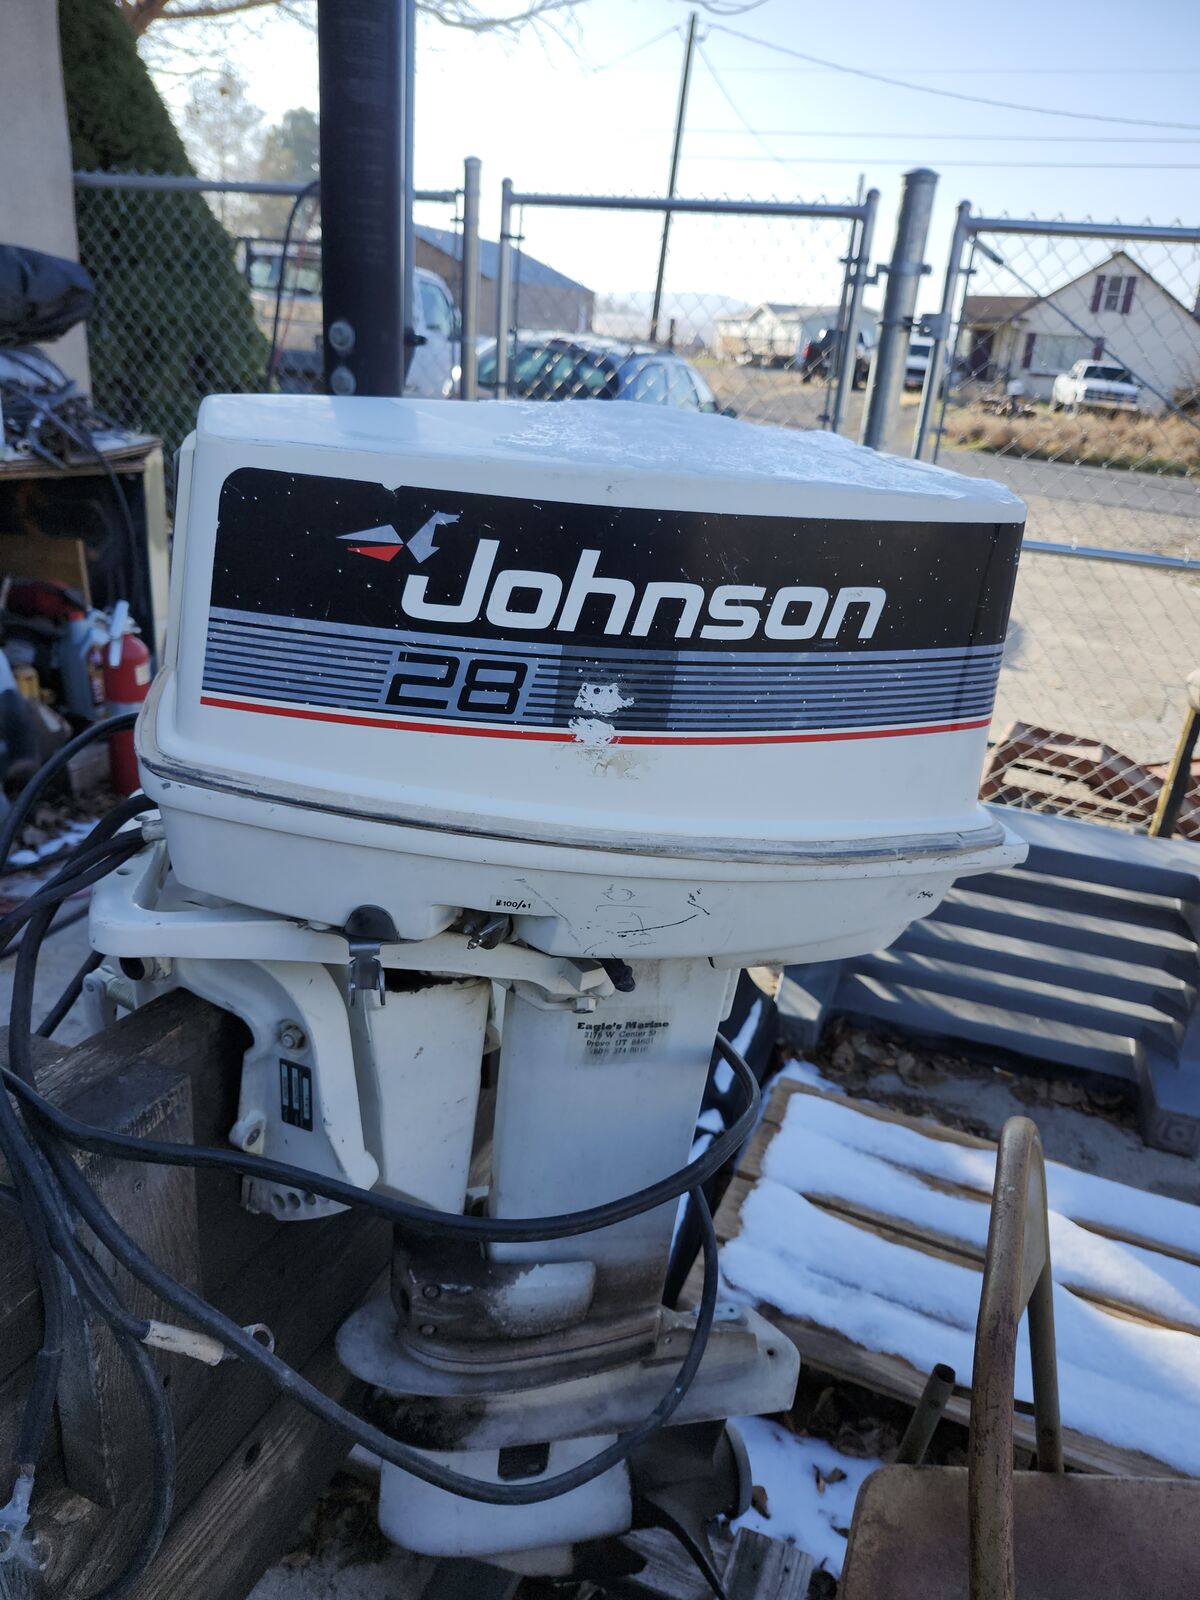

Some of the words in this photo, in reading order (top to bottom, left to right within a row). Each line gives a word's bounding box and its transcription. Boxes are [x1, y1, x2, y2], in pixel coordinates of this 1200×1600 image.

[401, 538, 888, 641] Johnson
[384, 651, 529, 715] 28
[577, 1022, 622, 1031] Eagle's
[625, 1021, 669, 1029] Marine
[605, 1031, 615, 1039] W
[618, 1030, 646, 1038] Center
